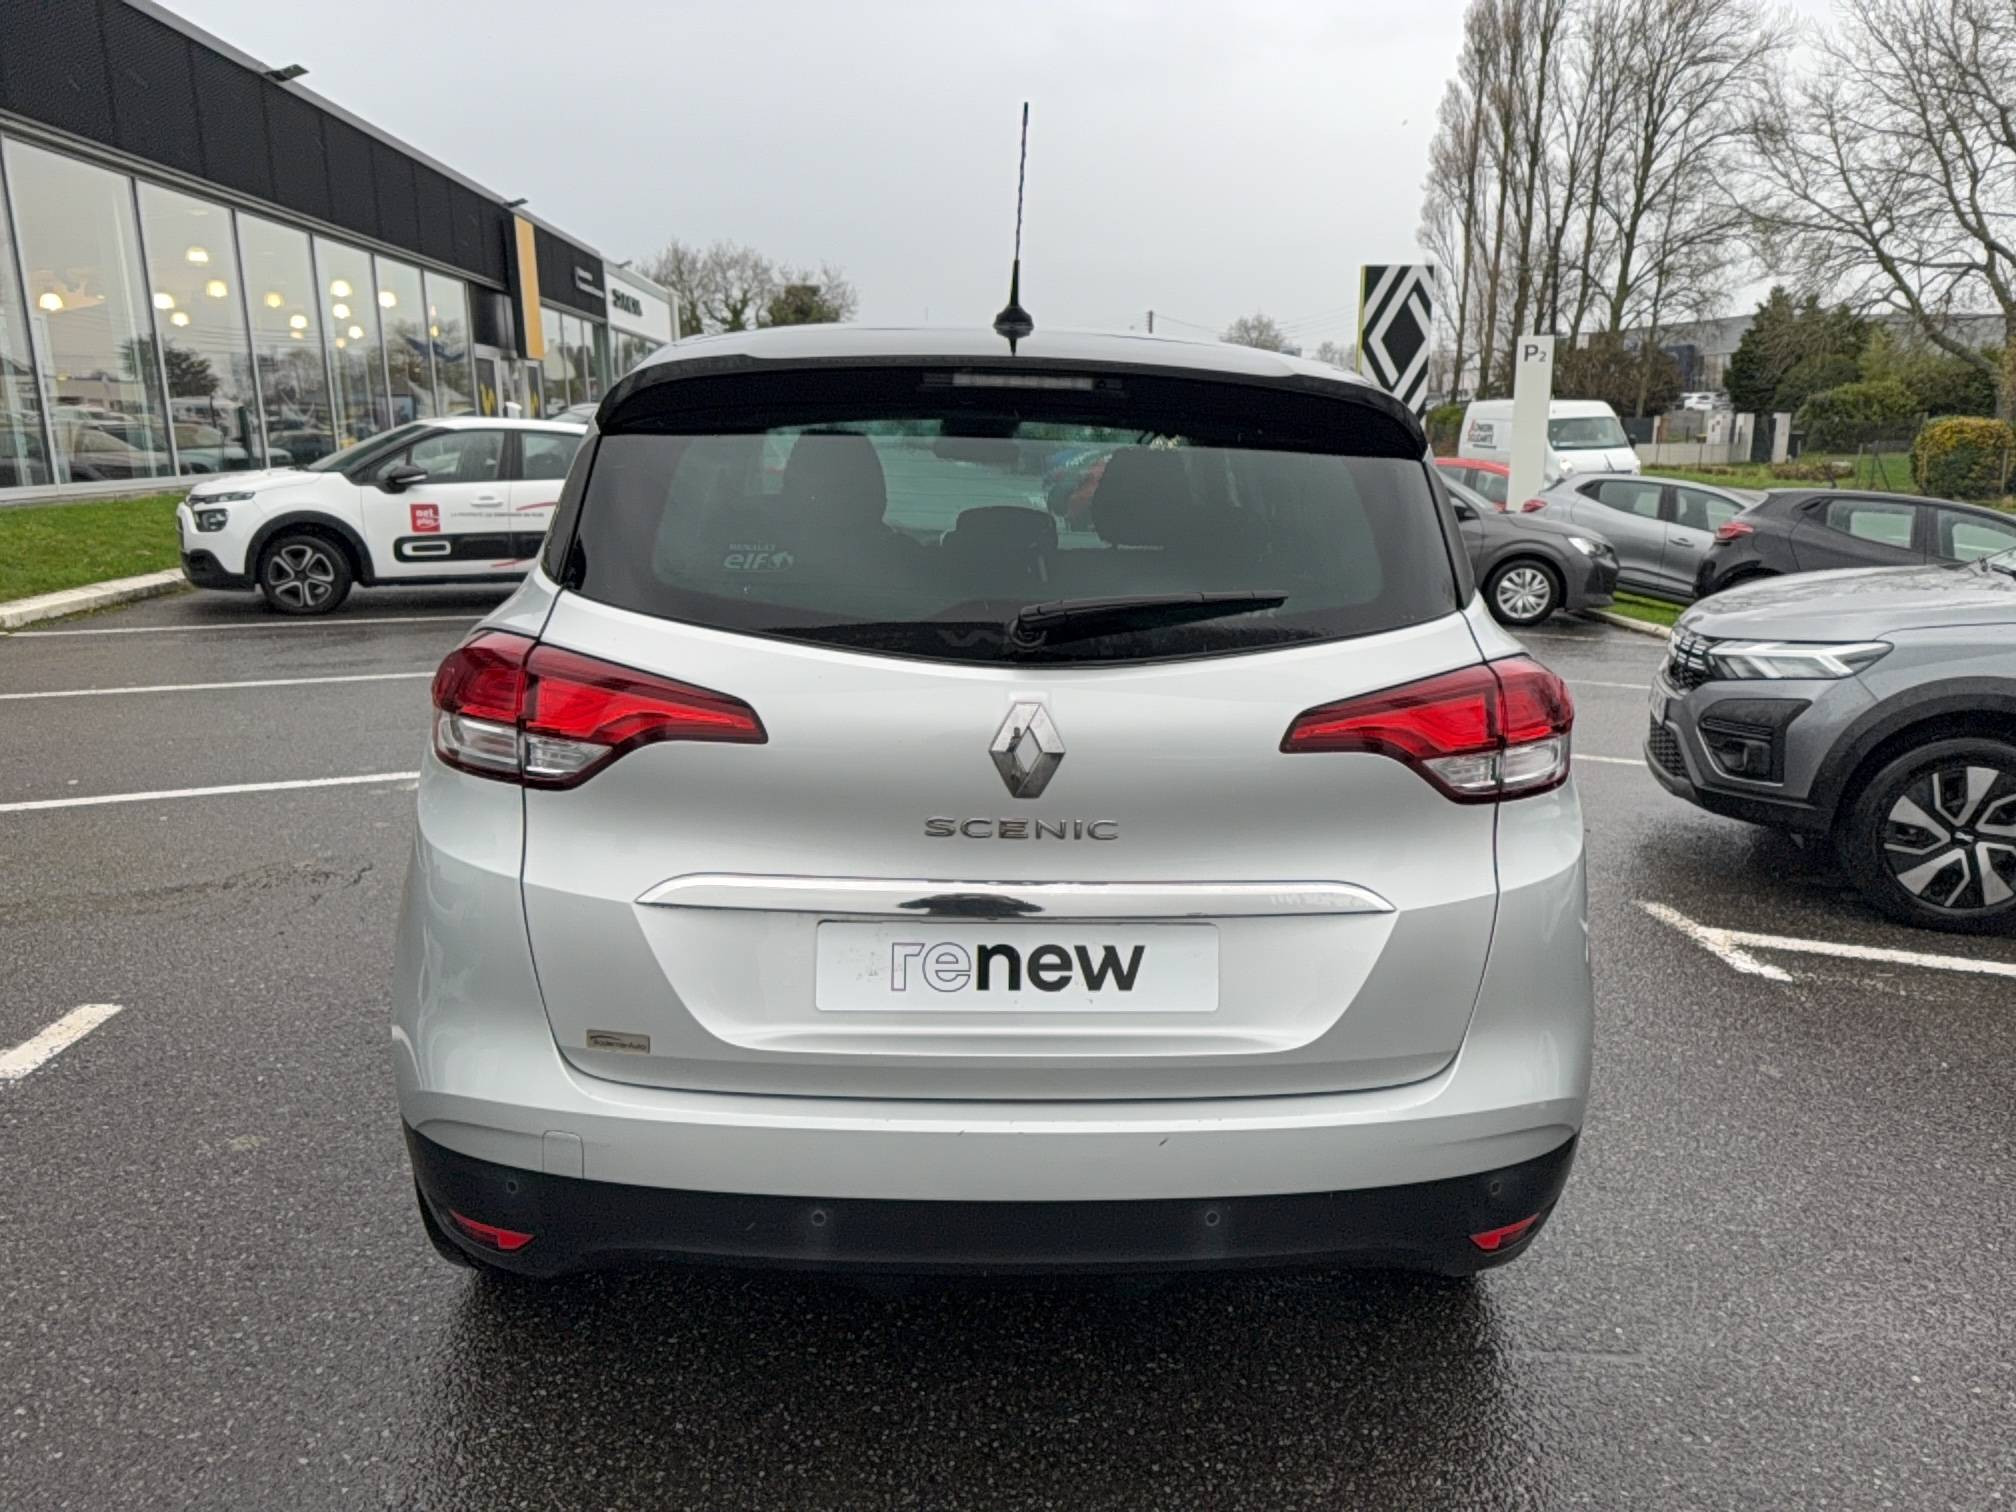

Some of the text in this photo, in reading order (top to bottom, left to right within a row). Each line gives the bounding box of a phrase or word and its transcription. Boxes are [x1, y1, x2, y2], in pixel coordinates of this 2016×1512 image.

[723, 553, 768, 569] elf
[925, 816, 1119, 841] SCENIC
[891, 942, 1145, 993] renew
